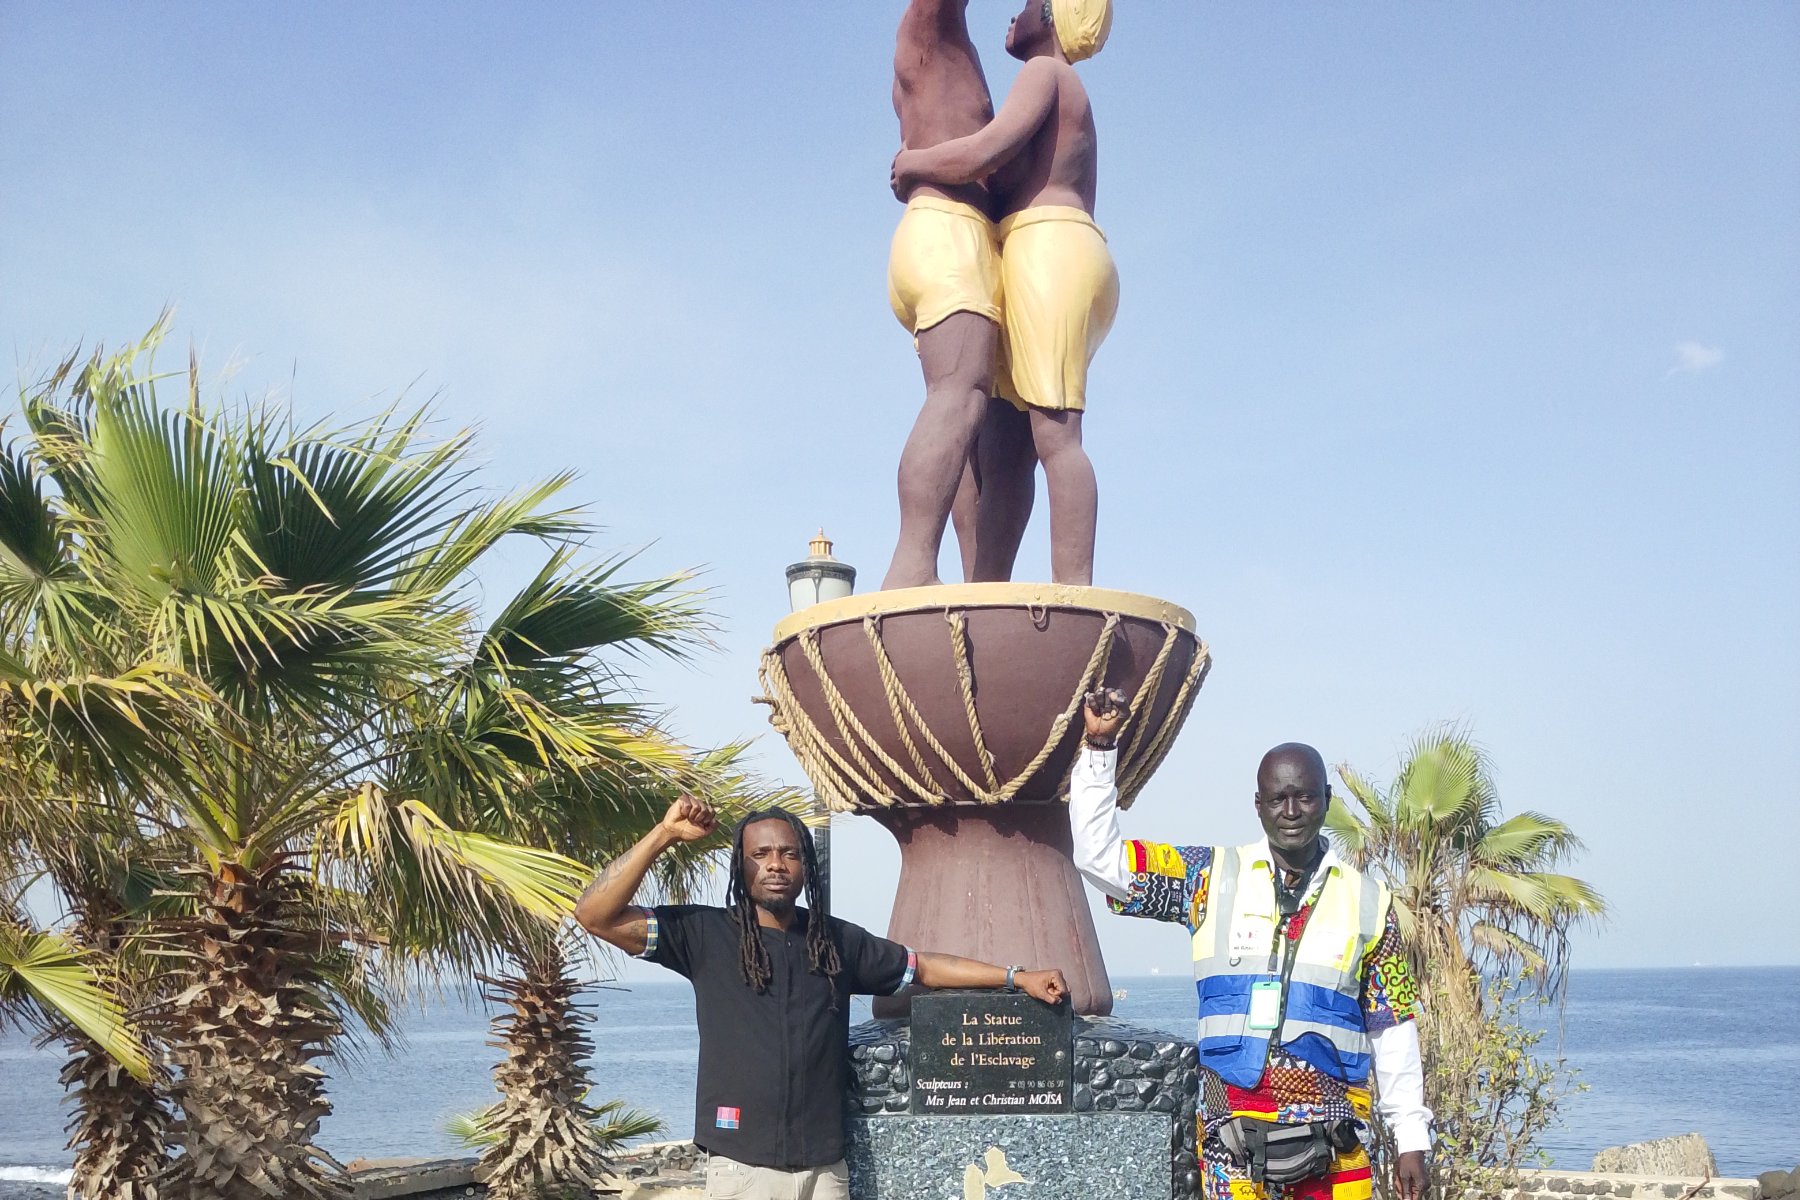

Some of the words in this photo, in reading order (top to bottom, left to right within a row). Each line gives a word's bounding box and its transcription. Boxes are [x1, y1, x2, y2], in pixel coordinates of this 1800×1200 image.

[962, 1013, 978, 1026] La
[984, 1013, 1023, 1026] Statue
[941, 1034, 957, 1046] de
[962, 1033, 973, 1046] la
[979, 1032, 1041, 1046] Libération
[950, 1053, 964, 1066] de
[971, 1052, 1036, 1069] l'Esclavage
[925, 1095, 944, 1106] Mrs
[946, 1094, 967, 1108] Jean
[970, 1096, 979, 1106] et
[982, 1093, 1025, 1106] Christian
